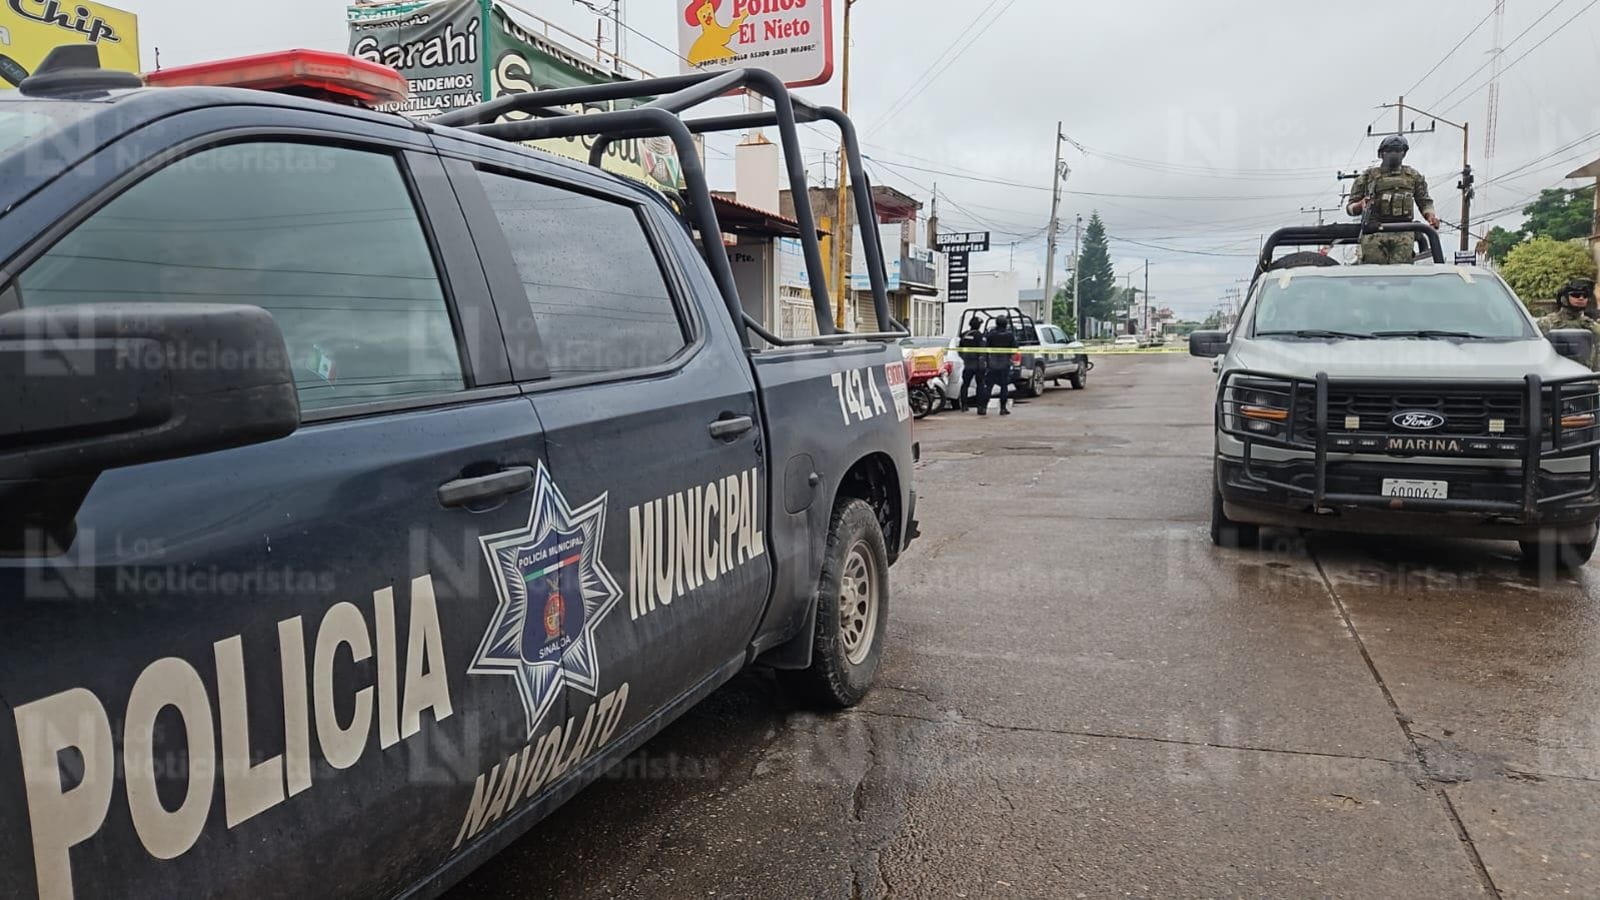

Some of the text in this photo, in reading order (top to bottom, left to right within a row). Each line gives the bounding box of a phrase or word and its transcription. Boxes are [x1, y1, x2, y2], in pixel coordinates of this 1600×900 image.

[7, 0, 121, 43] Chip
[732, 0, 807, 19] Pollos
[738, 18, 811, 45] El Nieto
[353, 18, 480, 70] Sarahí
[407, 74, 473, 93] ENDEMOS
[453, 91, 482, 108] MÁS
[830, 368, 873, 426] 742
[867, 366, 888, 416] A
[1402, 414, 1434, 427] Ford
[1389, 438, 1459, 452] MARINA
[1391, 486, 1438, 500] 600067
[548, 537, 584, 557] MUNICIPAL
[629, 467, 765, 621] MUNICIPAL
[538, 635, 571, 659] SINALOA
[14, 573, 454, 900] POLICIA
[450, 682, 630, 851] NAVOLATO
